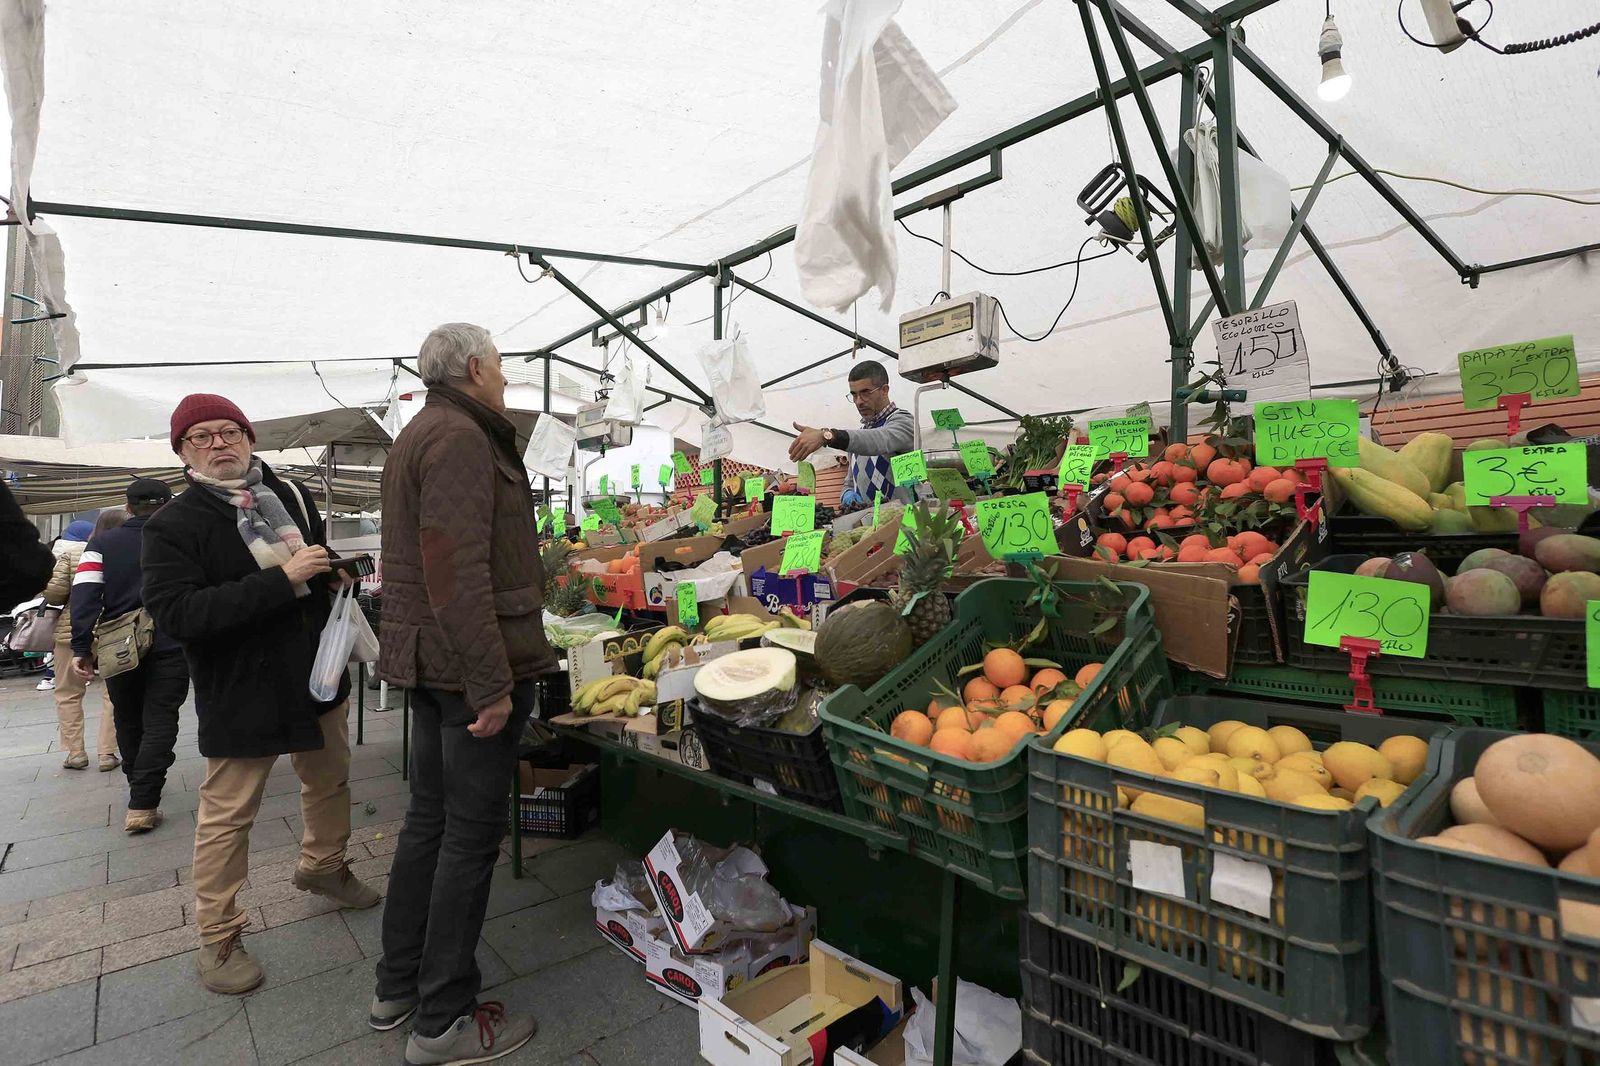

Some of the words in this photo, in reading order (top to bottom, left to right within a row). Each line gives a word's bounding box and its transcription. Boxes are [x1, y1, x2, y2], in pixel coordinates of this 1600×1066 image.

[1462, 343, 1536, 368] PAPAYA
[1252, 369, 1275, 379] KILO
[1536, 388, 1569, 398] KILO
[1268, 421, 1351, 442] HUESO
[1522, 446, 1568, 456] EXTRA
[1528, 487, 1566, 496] KILO
[982, 500, 1028, 511] FRESCA
[661, 874, 681, 916] CAROL
[666, 970, 697, 993] CAROL
